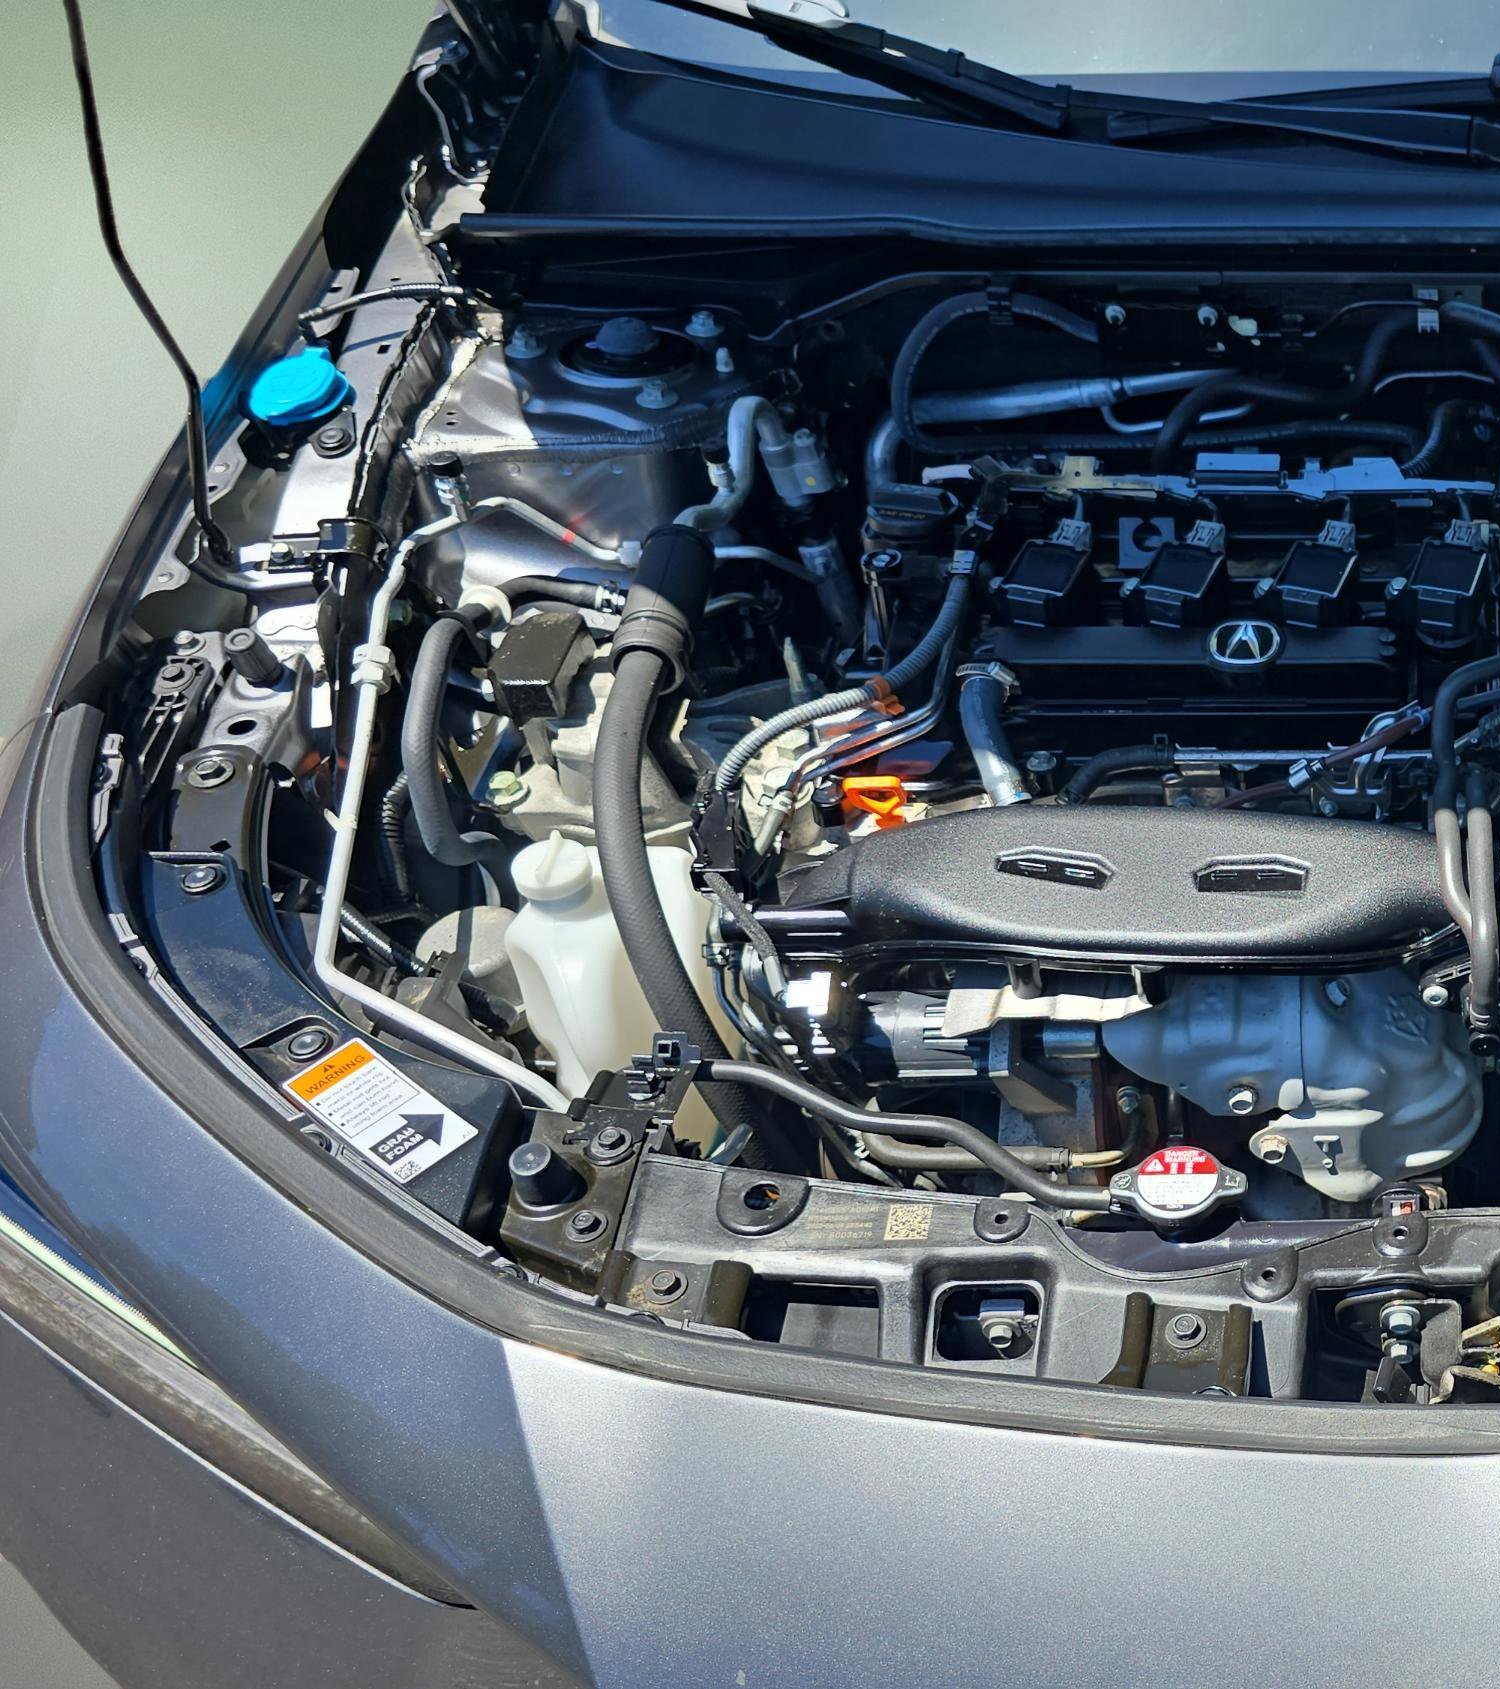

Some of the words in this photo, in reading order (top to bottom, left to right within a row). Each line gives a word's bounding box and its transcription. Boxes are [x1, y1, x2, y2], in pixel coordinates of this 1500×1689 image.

[305, 1055, 366, 1094] WARNING
[378, 1127, 416, 1153] GRAB
[386, 1134, 425, 1161] FOAM
